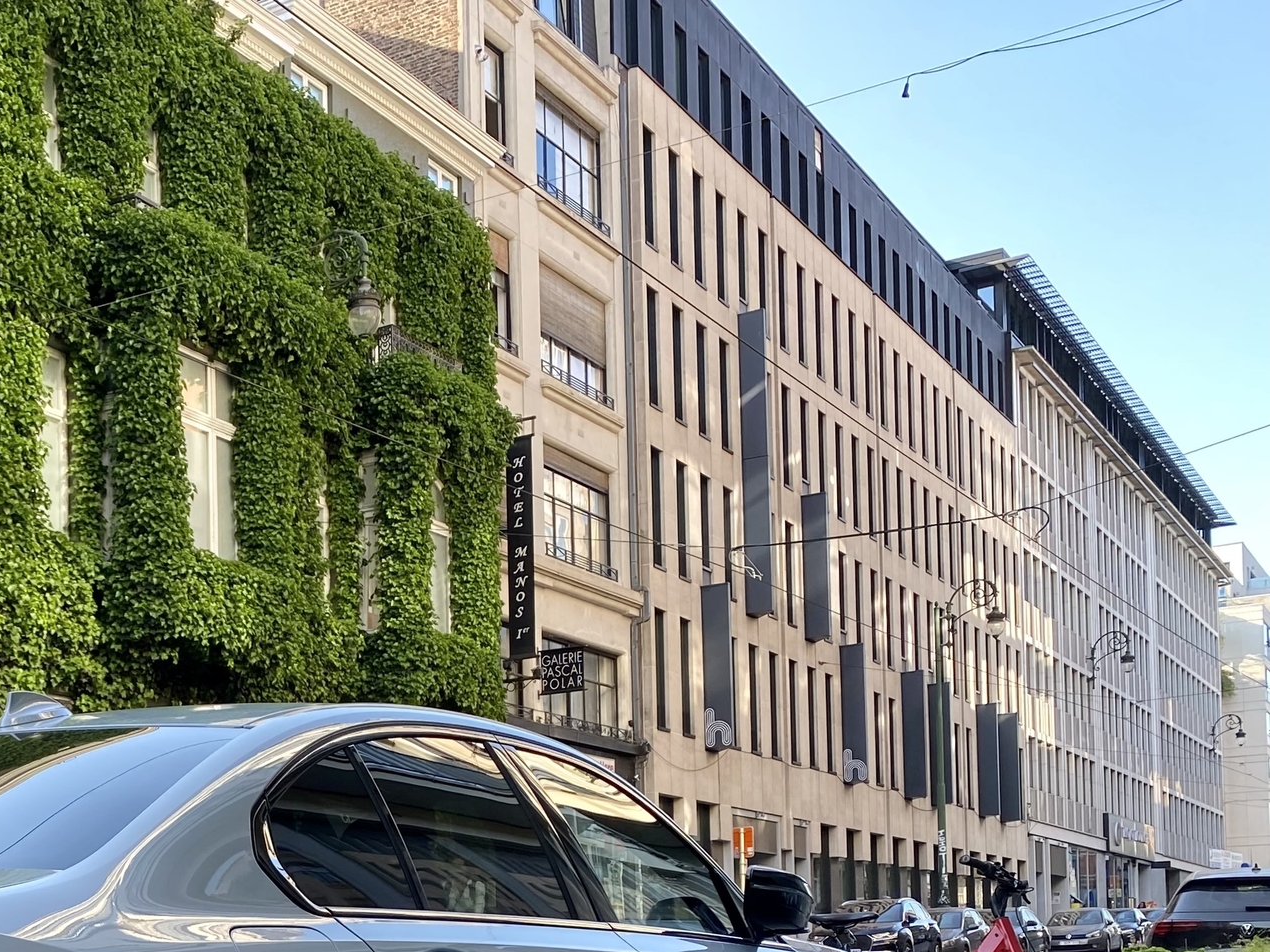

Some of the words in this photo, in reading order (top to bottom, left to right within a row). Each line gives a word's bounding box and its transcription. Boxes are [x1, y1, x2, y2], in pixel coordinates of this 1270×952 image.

[512, 455, 526, 528] HOTEL
[513, 545, 528, 618] MANOS
[541, 650, 583, 667] GALERIE
[541, 663, 583, 679] PASCAL
[541, 675, 583, 692] POLAR
